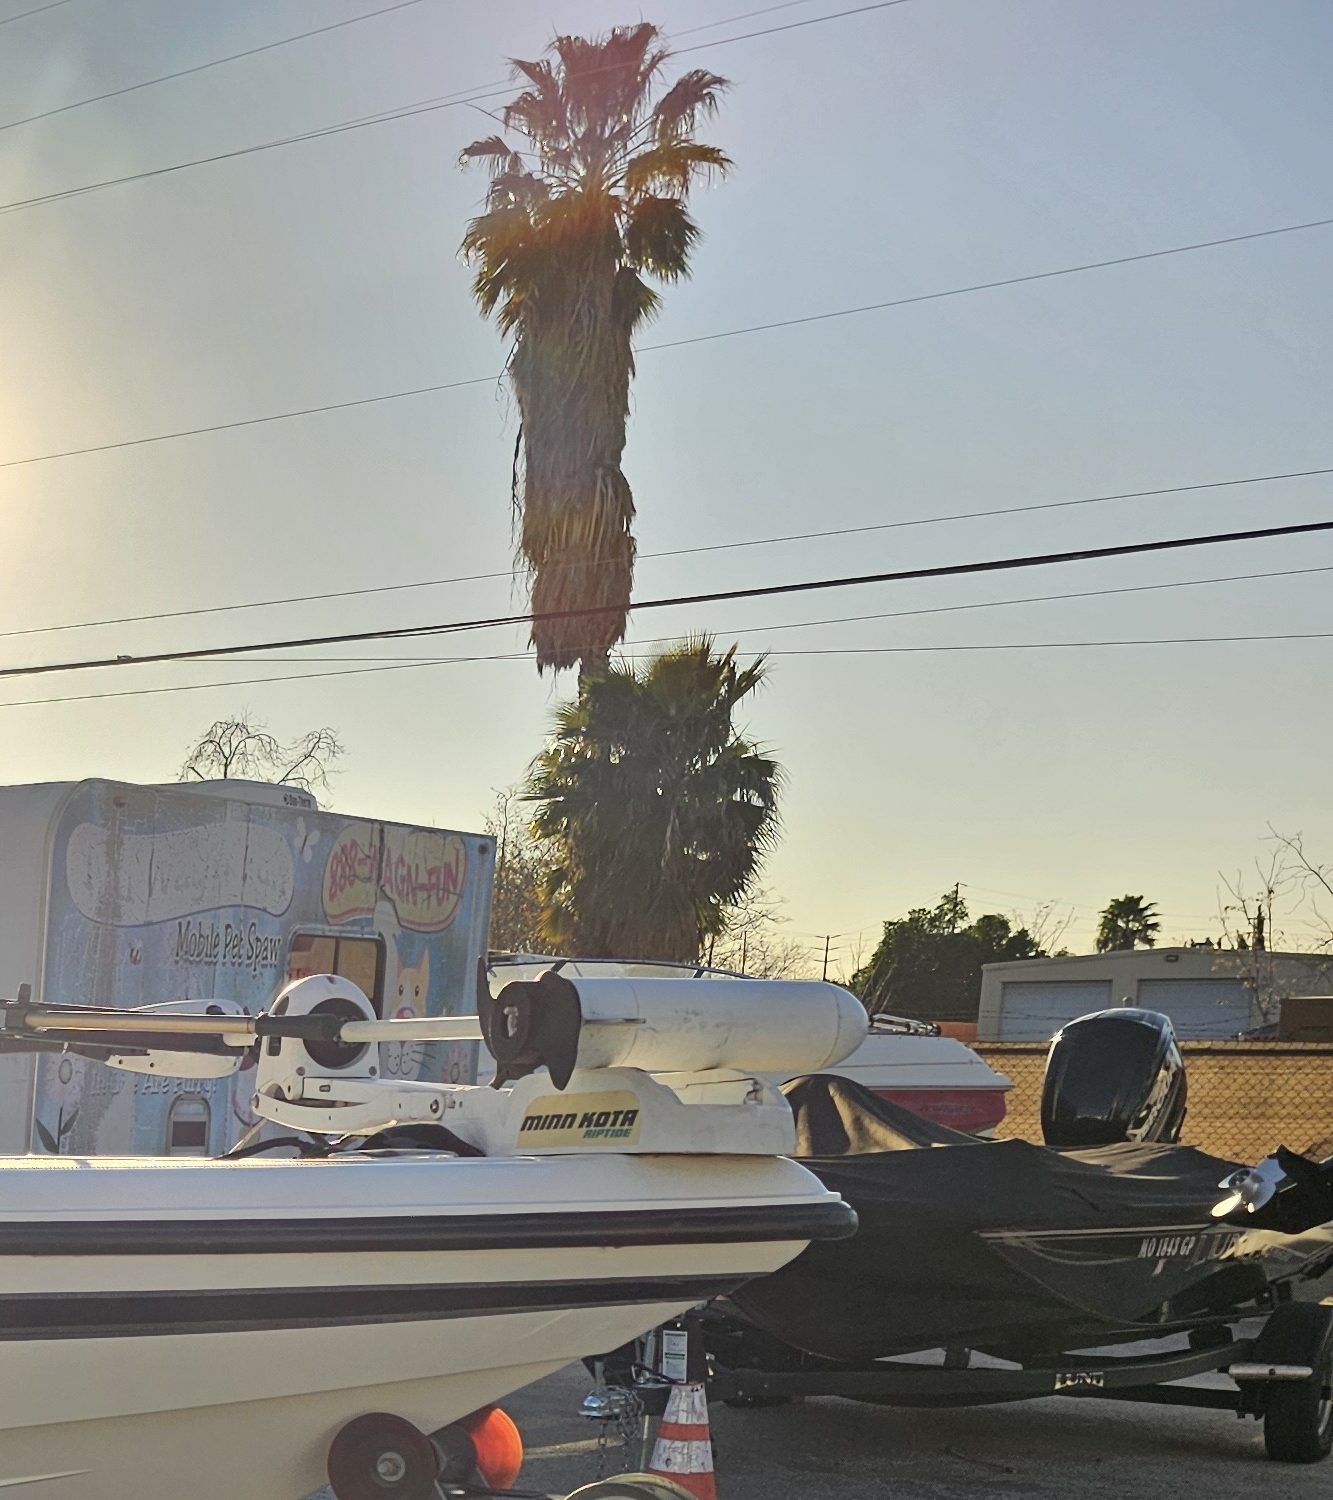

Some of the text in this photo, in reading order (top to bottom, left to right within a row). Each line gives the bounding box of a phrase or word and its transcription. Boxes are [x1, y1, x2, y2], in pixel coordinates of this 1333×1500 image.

[174, 919, 221, 961] Mobile
[222, 921, 244, 962] Pet
[520, 1109, 639, 1132] MINN KOTA
[583, 1128, 633, 1139] RIPTIDE
